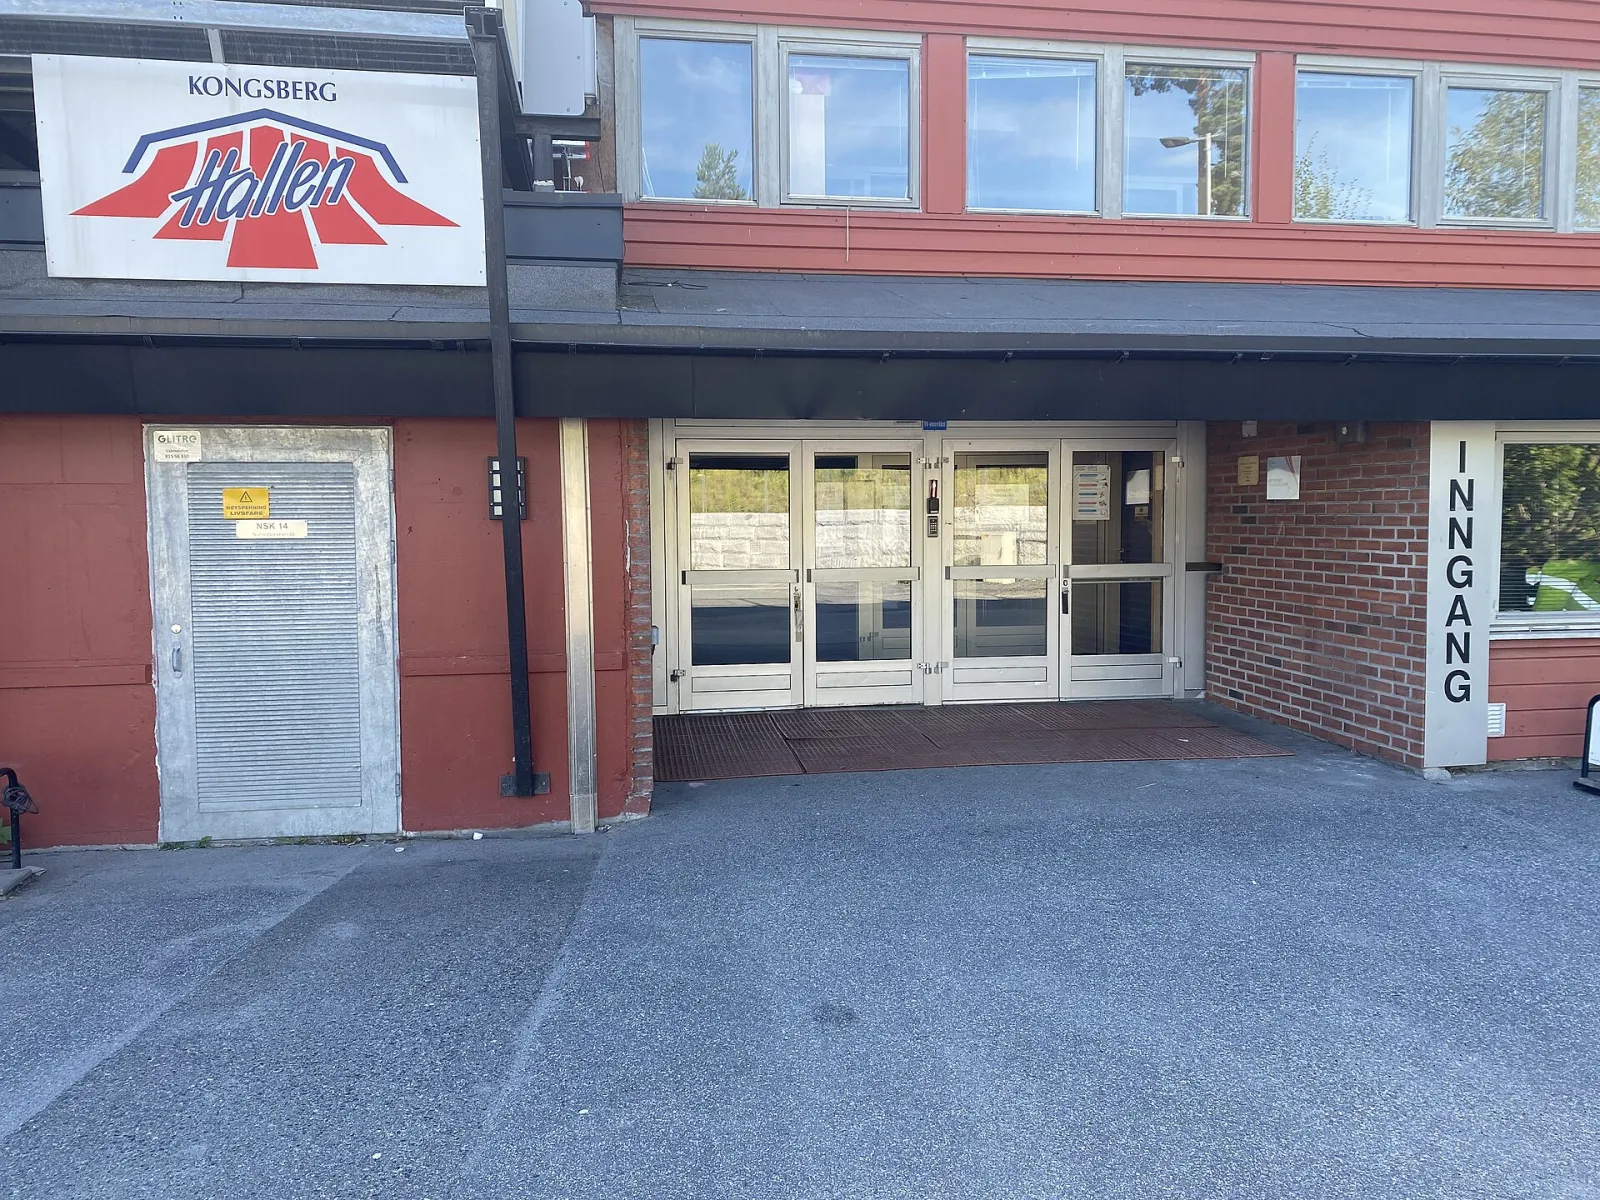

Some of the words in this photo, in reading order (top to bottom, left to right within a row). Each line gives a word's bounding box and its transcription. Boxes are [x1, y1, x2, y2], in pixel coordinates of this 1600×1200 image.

[188, 75, 338, 102] KONGSBERG
[171, 141, 355, 227] Hallen
[256, 522, 276, 530] NSK
[278, 522, 289, 530] 14
[1443, 440, 1475, 703] INNGANG
